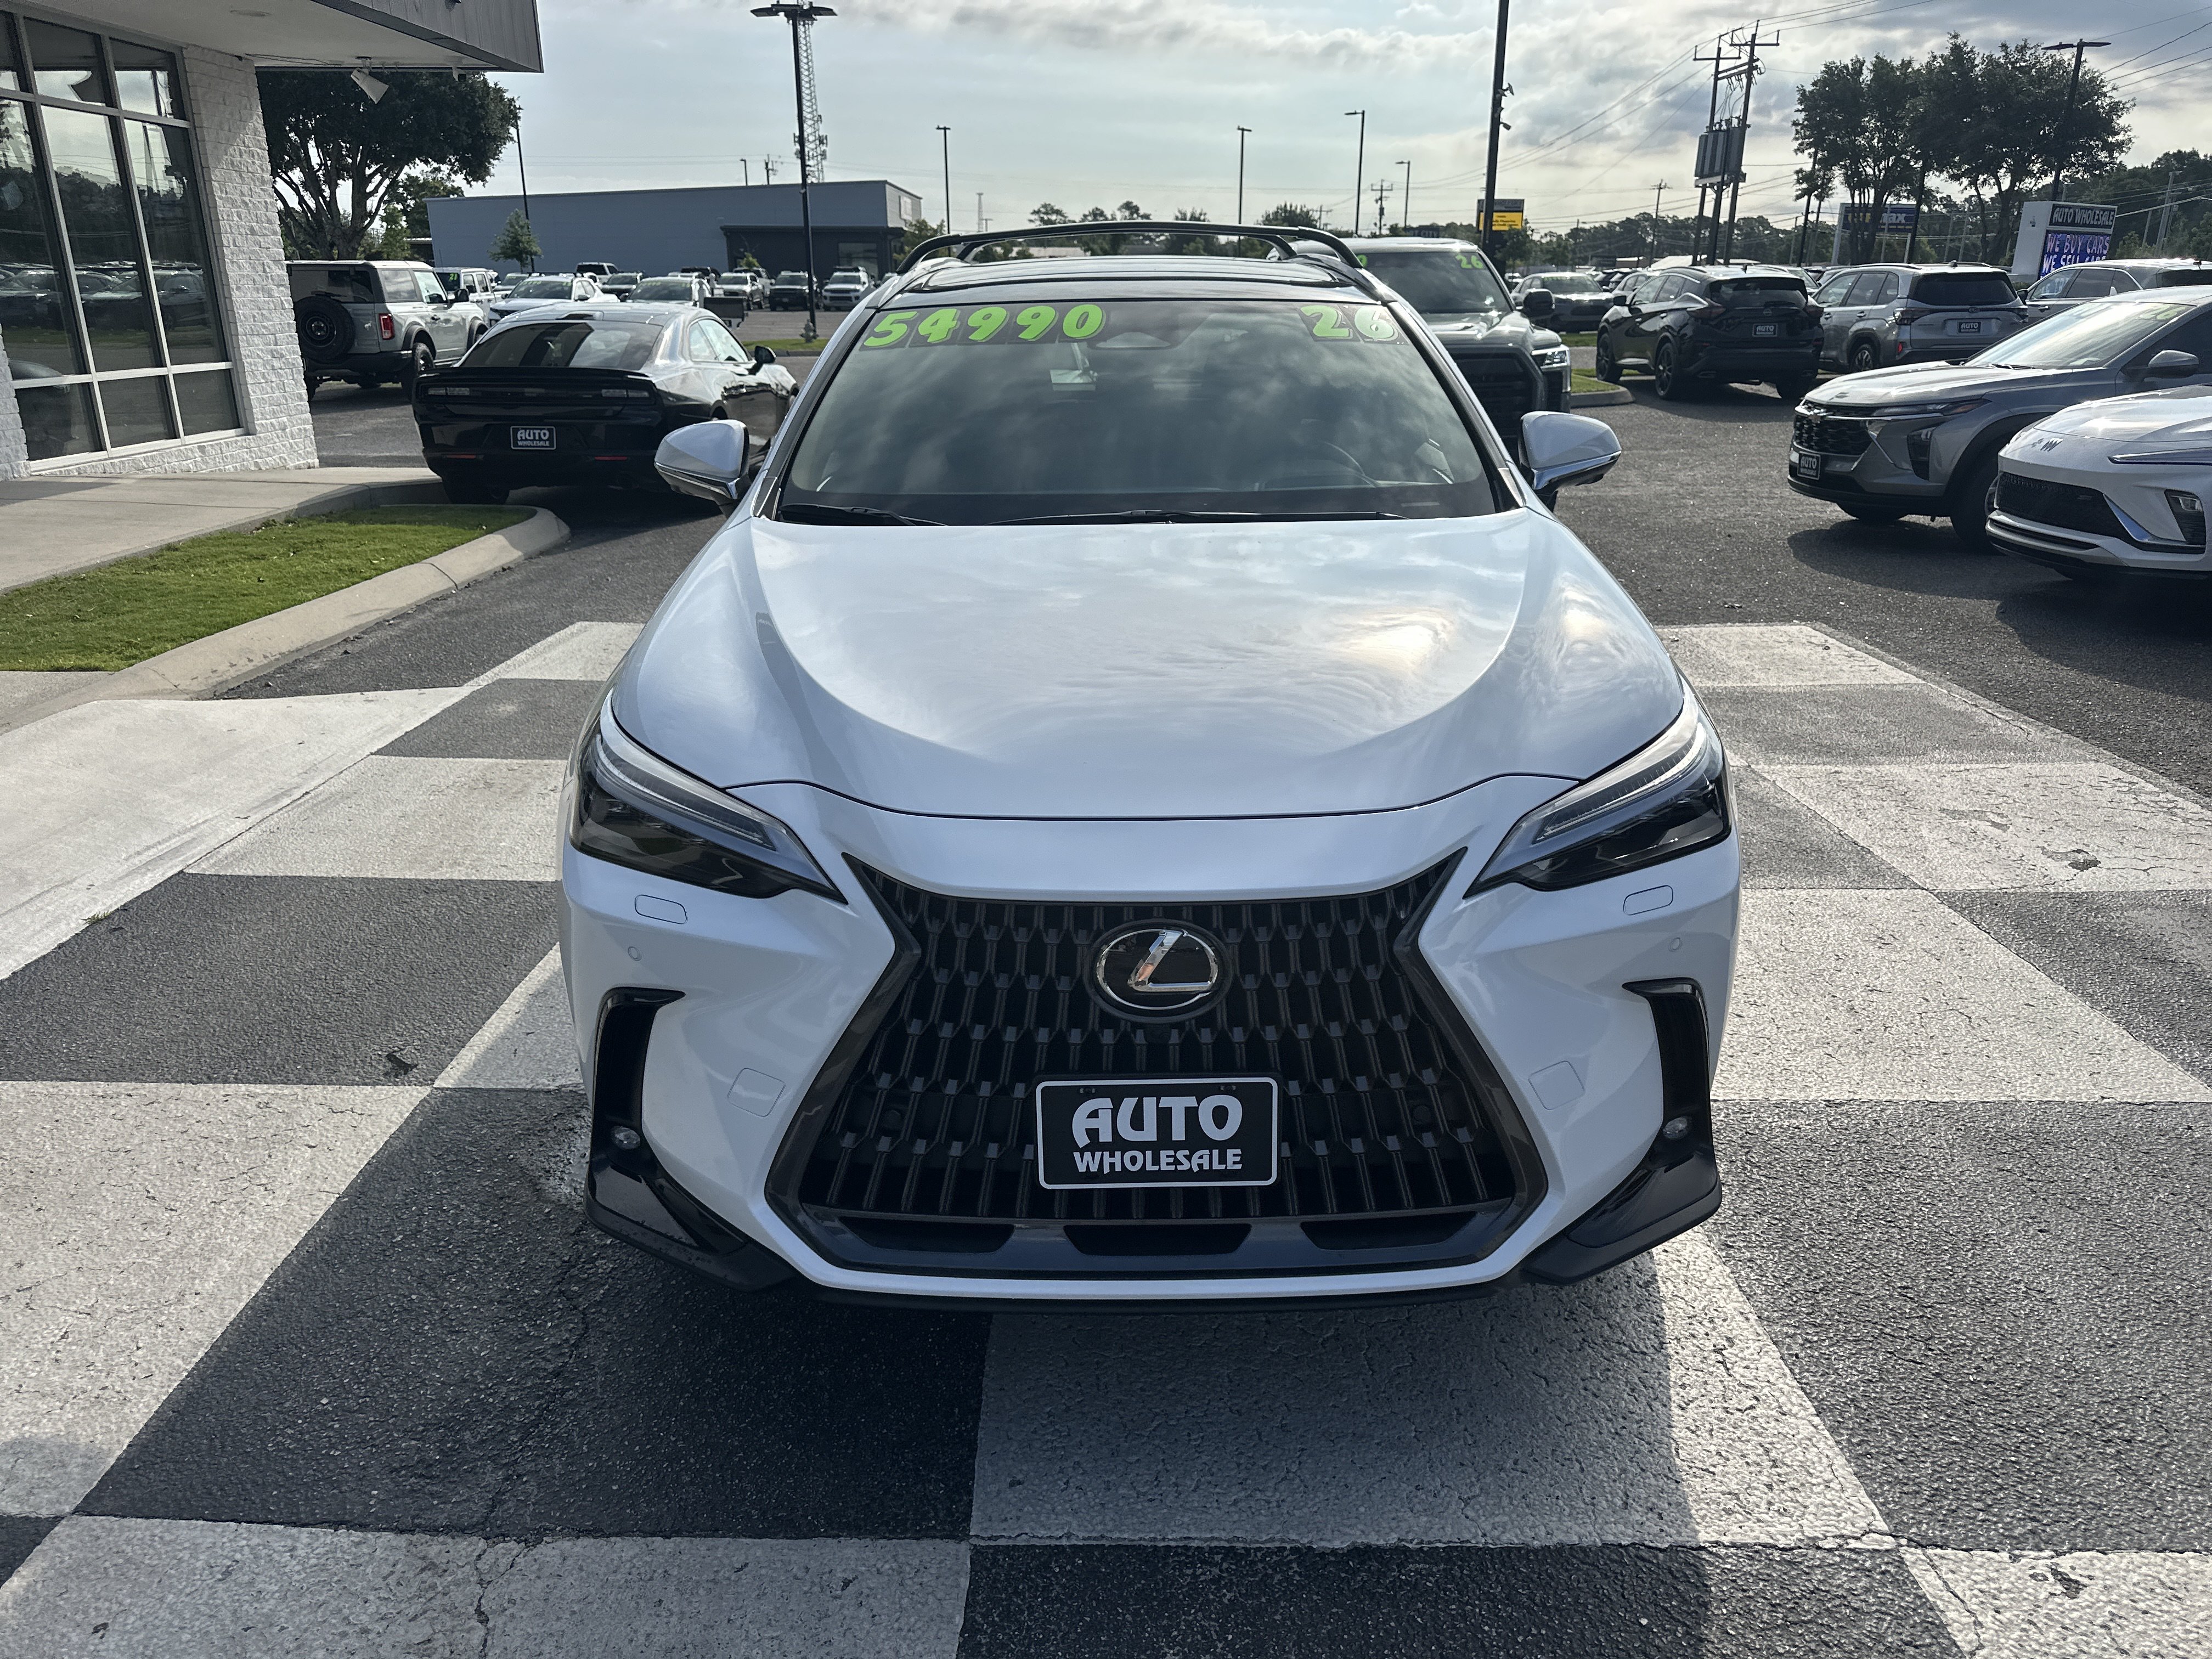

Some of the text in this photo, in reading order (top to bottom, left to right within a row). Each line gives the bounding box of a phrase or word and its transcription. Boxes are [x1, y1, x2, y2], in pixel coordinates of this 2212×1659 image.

[2053, 207, 2114, 225] AUTO WHOLESALE
[2046, 233, 2111, 255] WE BUY CARS
[1455, 254, 1484, 269] 26
[2042, 254, 2057, 274] WE
[864, 304, 1104, 347] 54990
[1300, 305, 1396, 339] 26
[517, 430, 549, 440] AUTO
[1801, 456, 1817, 469] AUTO
[1072, 1094, 1243, 1148] AUTO
[1073, 1149, 1243, 1175] WHOLESALE
